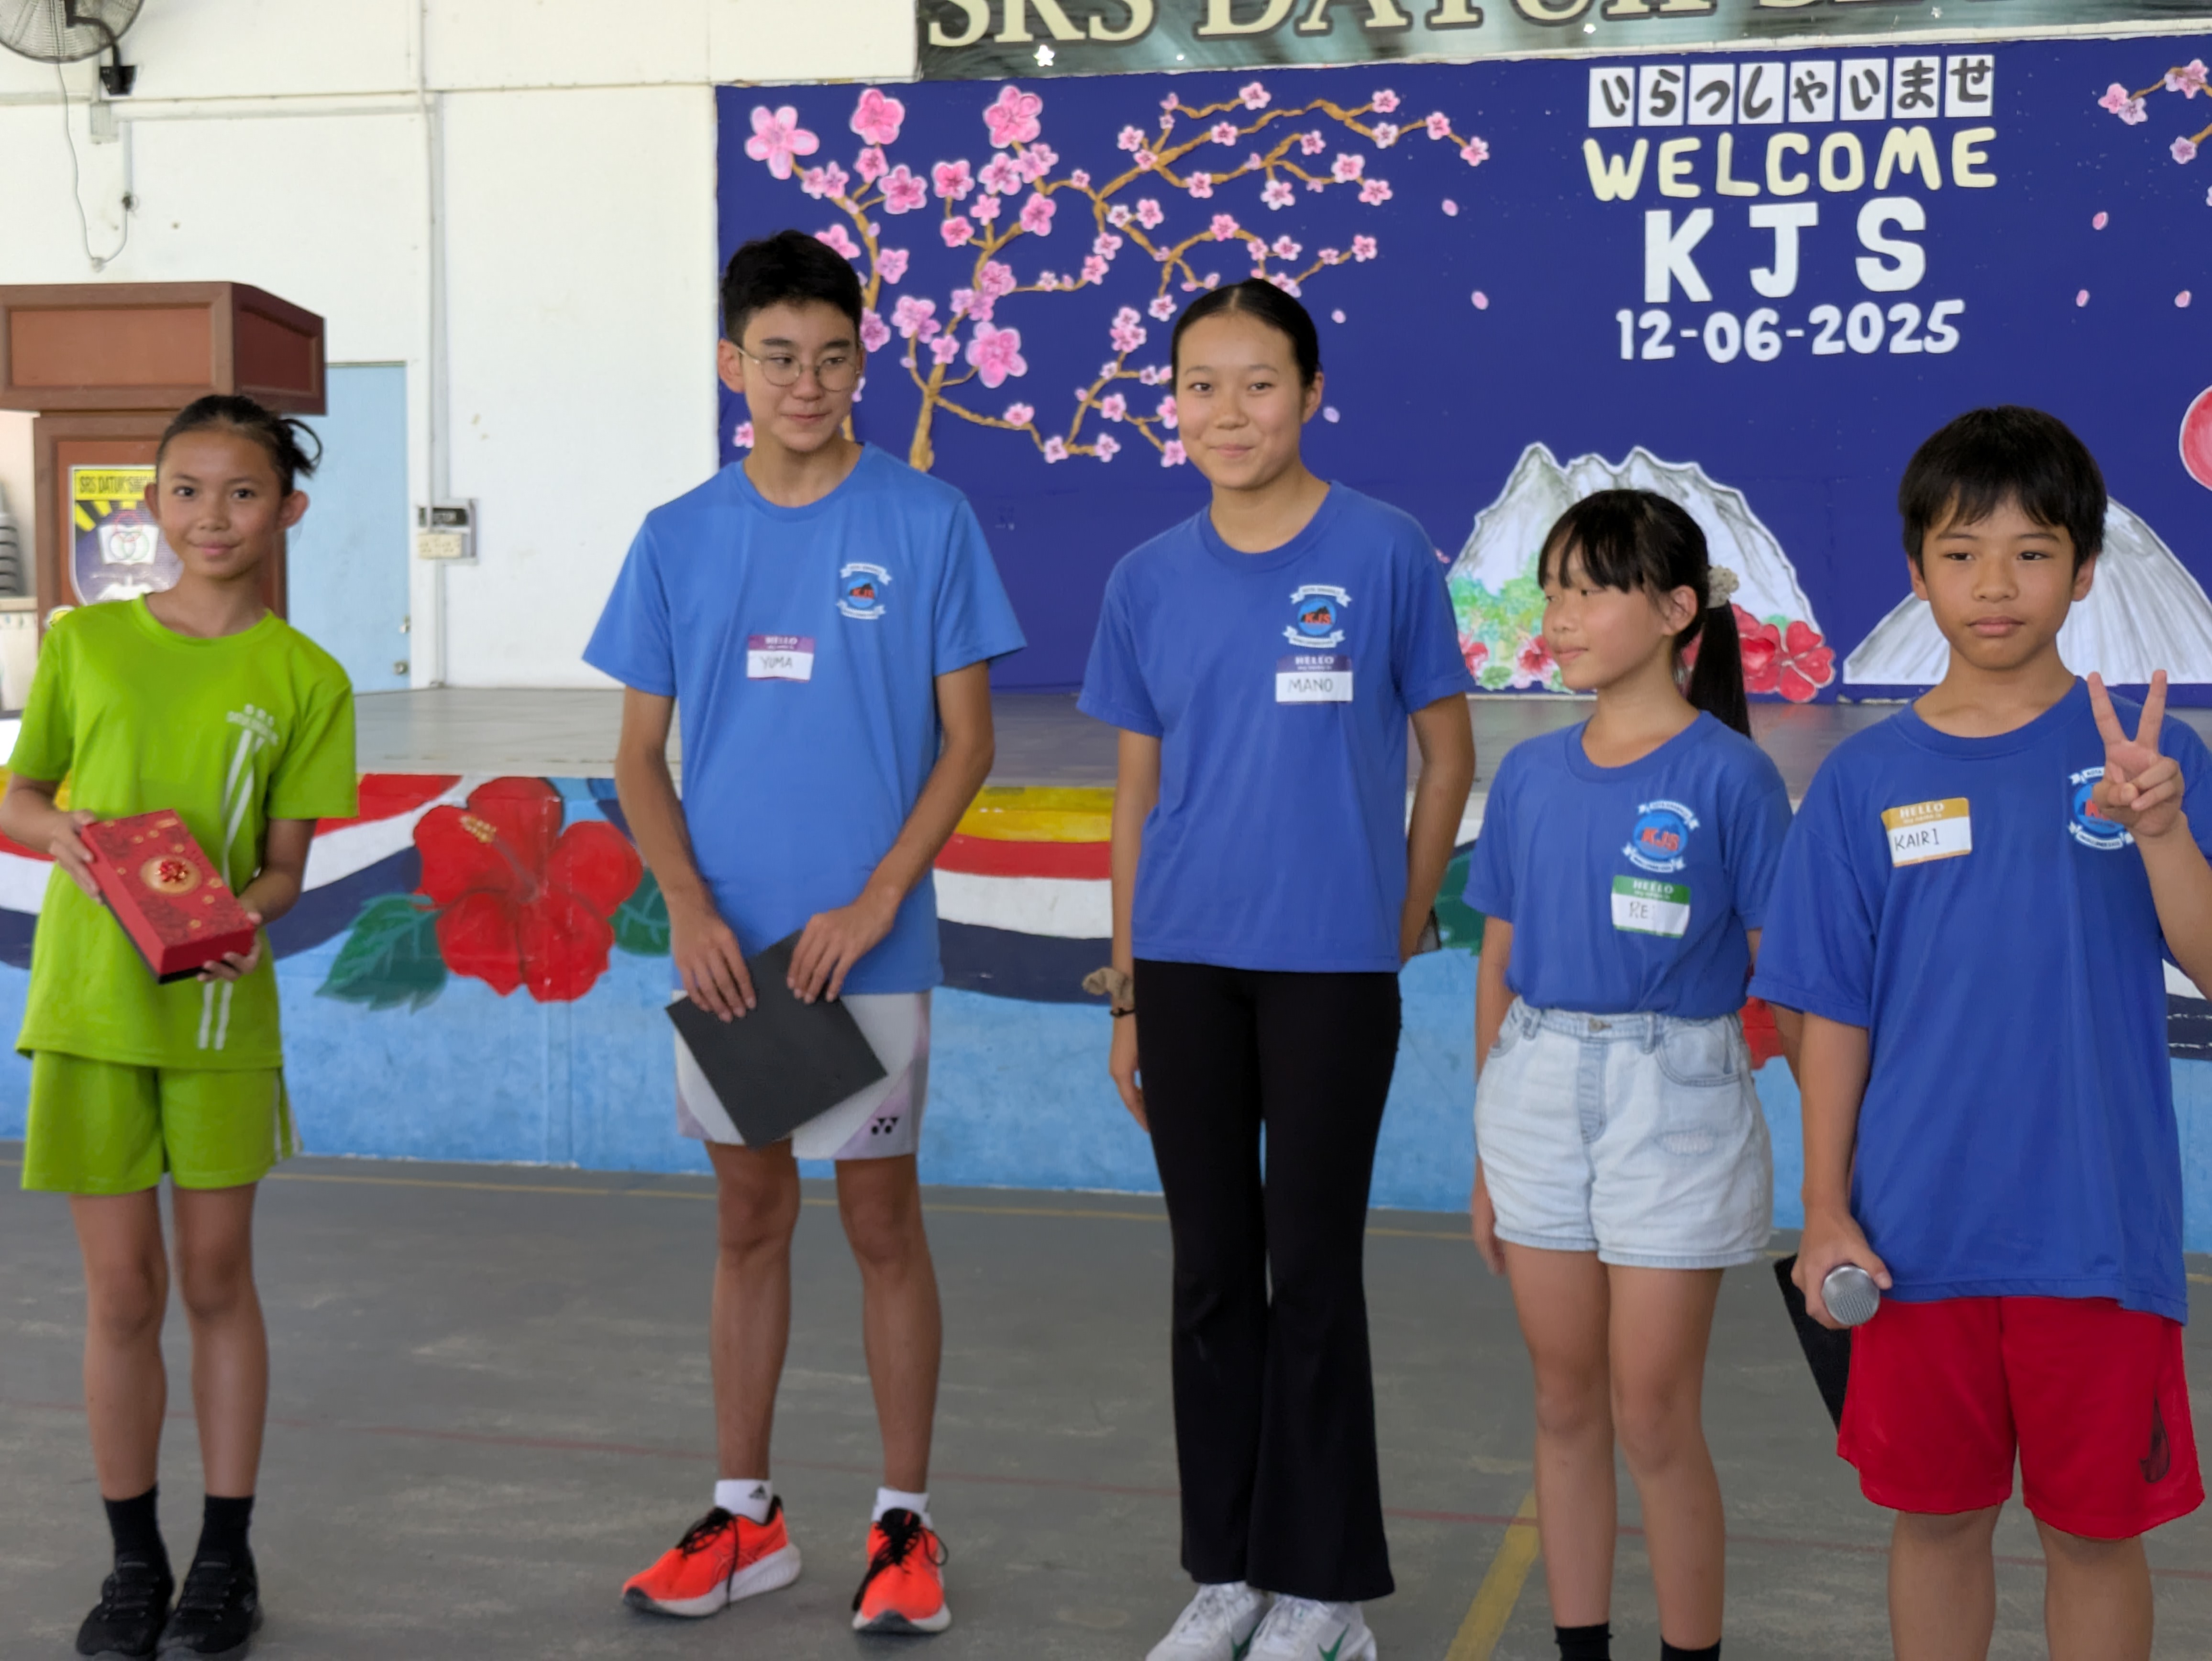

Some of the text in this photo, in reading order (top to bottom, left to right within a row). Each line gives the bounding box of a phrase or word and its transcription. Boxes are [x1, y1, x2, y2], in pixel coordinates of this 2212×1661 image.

[1583, 126, 1997, 201] WELCOME
[1616, 299, 1965, 363] 12-06-2025
[760, 656, 793, 669] YUMA
[1294, 655, 1334, 665] HELLO
[1288, 678, 1334, 693] MANO
[1900, 802, 1945, 819] HELLO
[1893, 828, 1939, 851] KAIRI
[1633, 879, 1674, 894] HELLO
